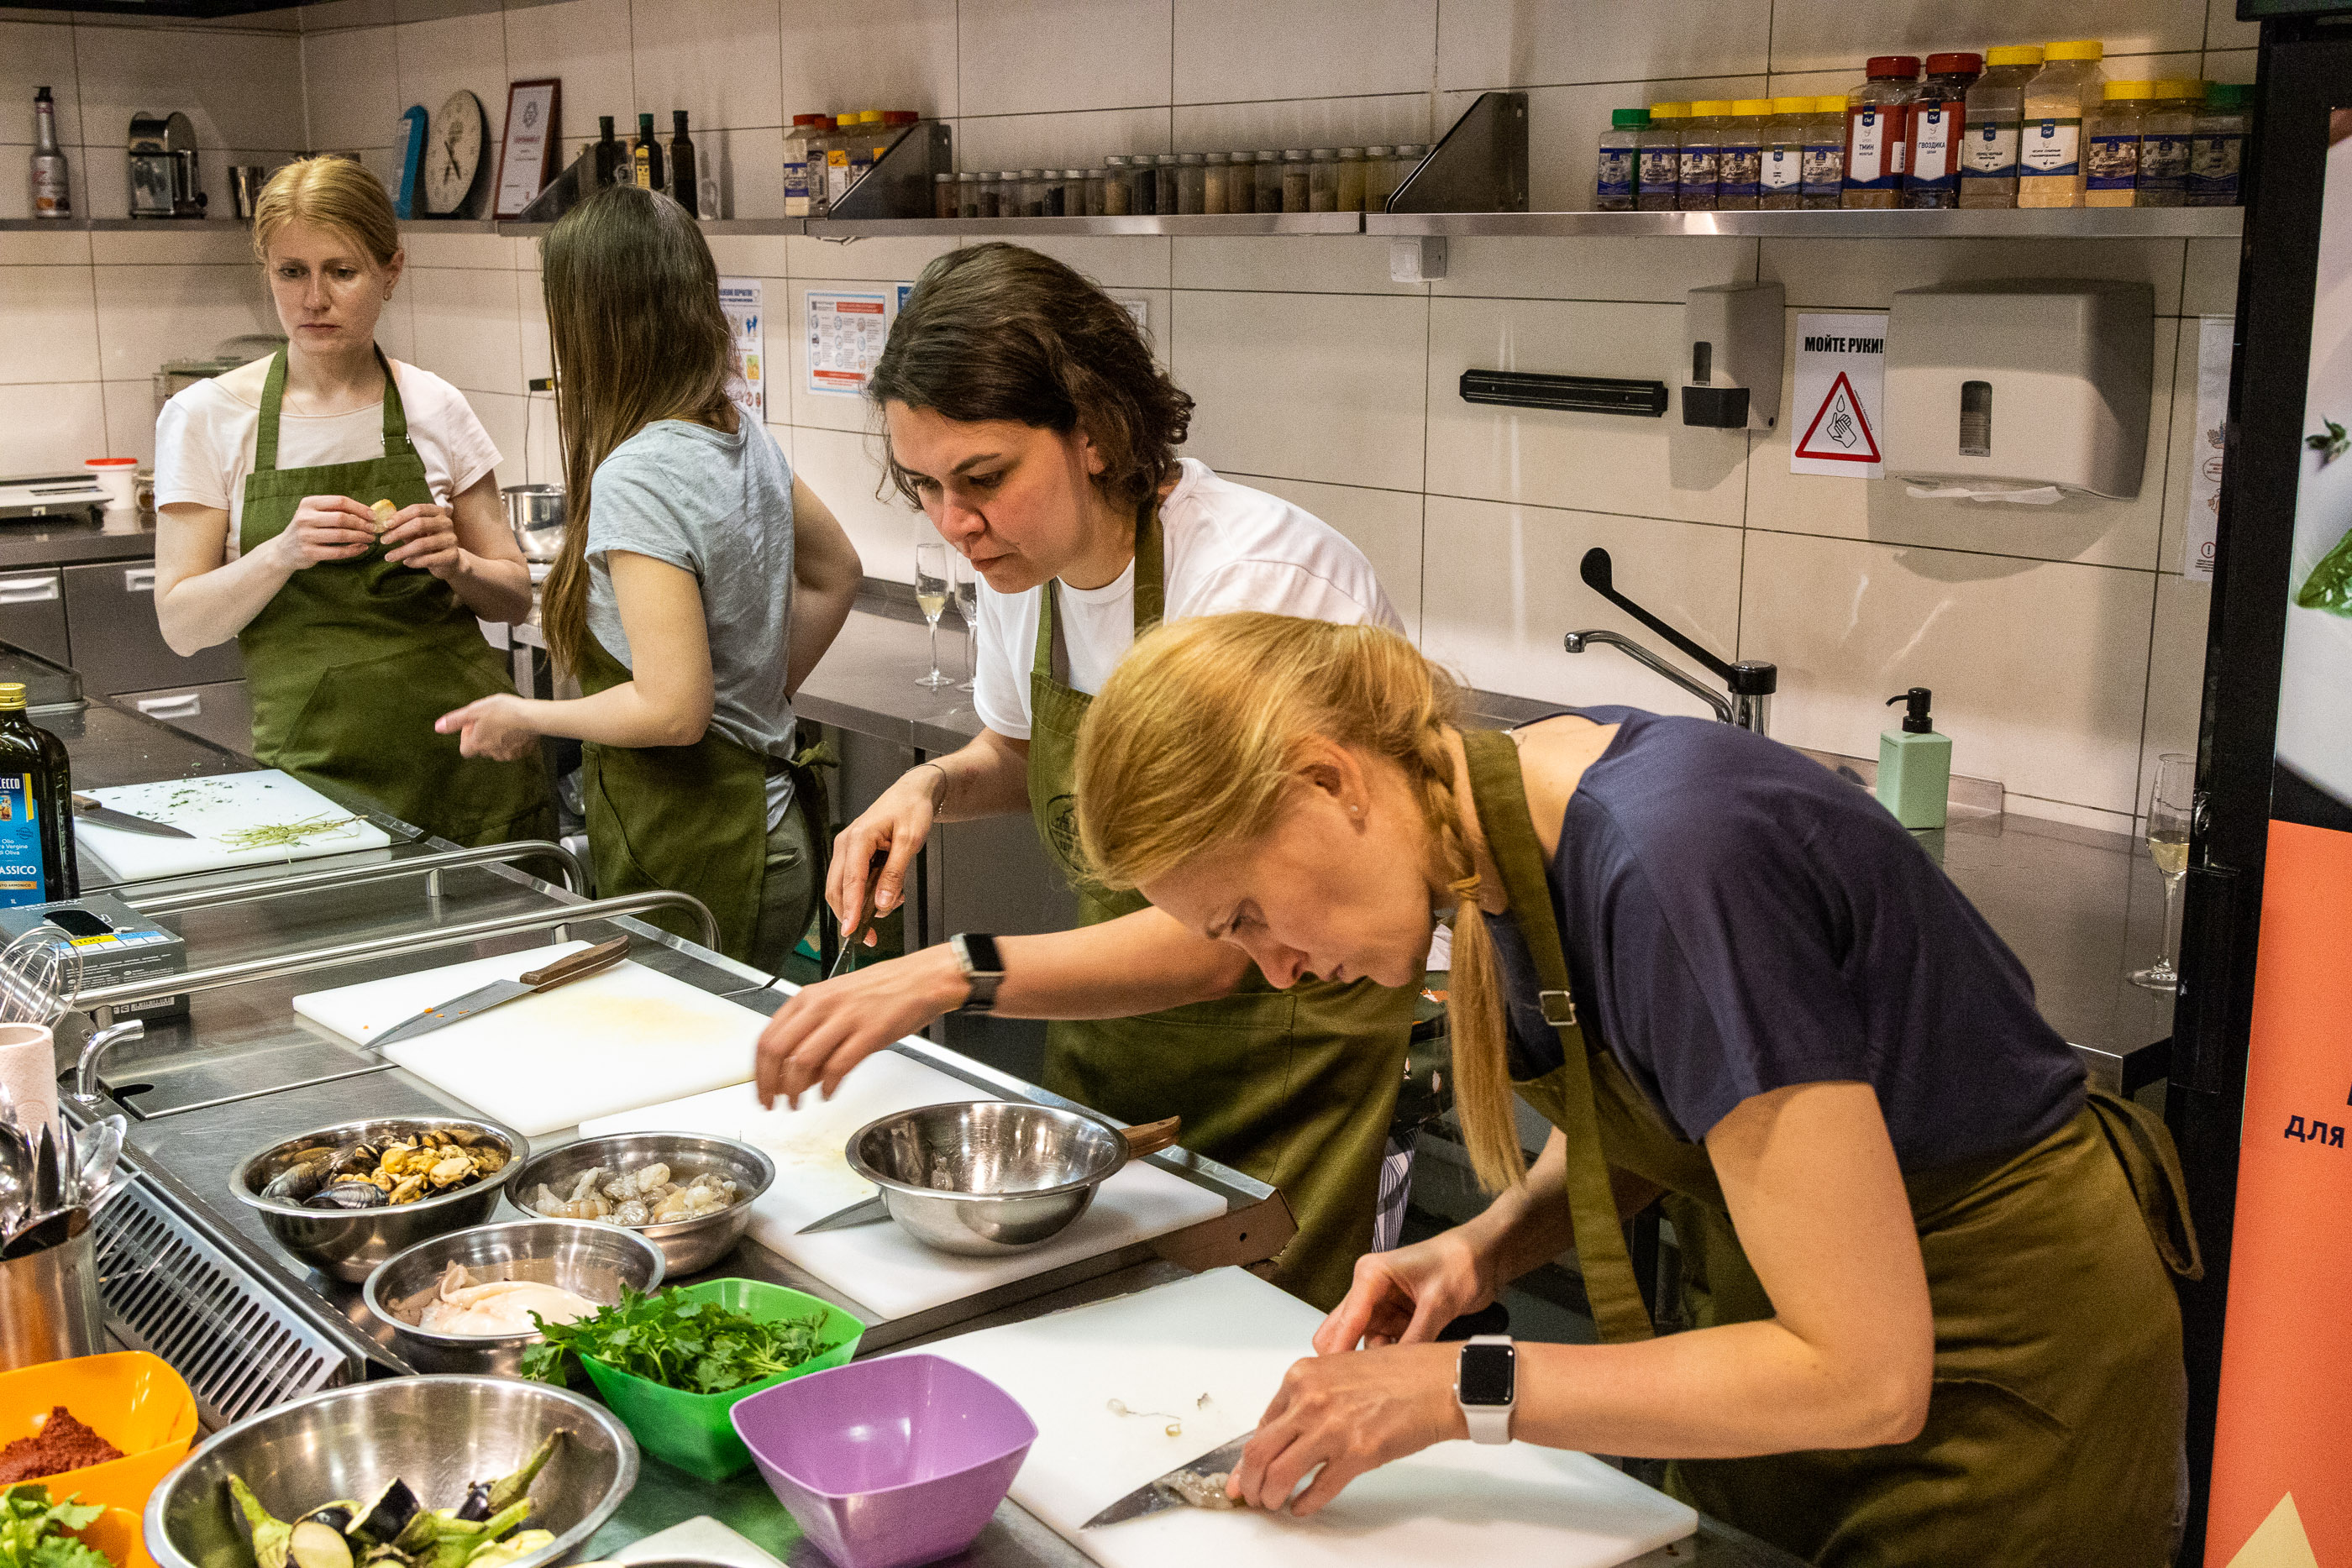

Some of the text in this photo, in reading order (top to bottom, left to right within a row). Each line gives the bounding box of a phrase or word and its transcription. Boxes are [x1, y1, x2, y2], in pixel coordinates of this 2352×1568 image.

[1804, 334, 1884, 354] МОЙТЕ РУКИ!
[0, 777, 21, 789] ECCO
[2284, 1114, 2345, 1149] для
